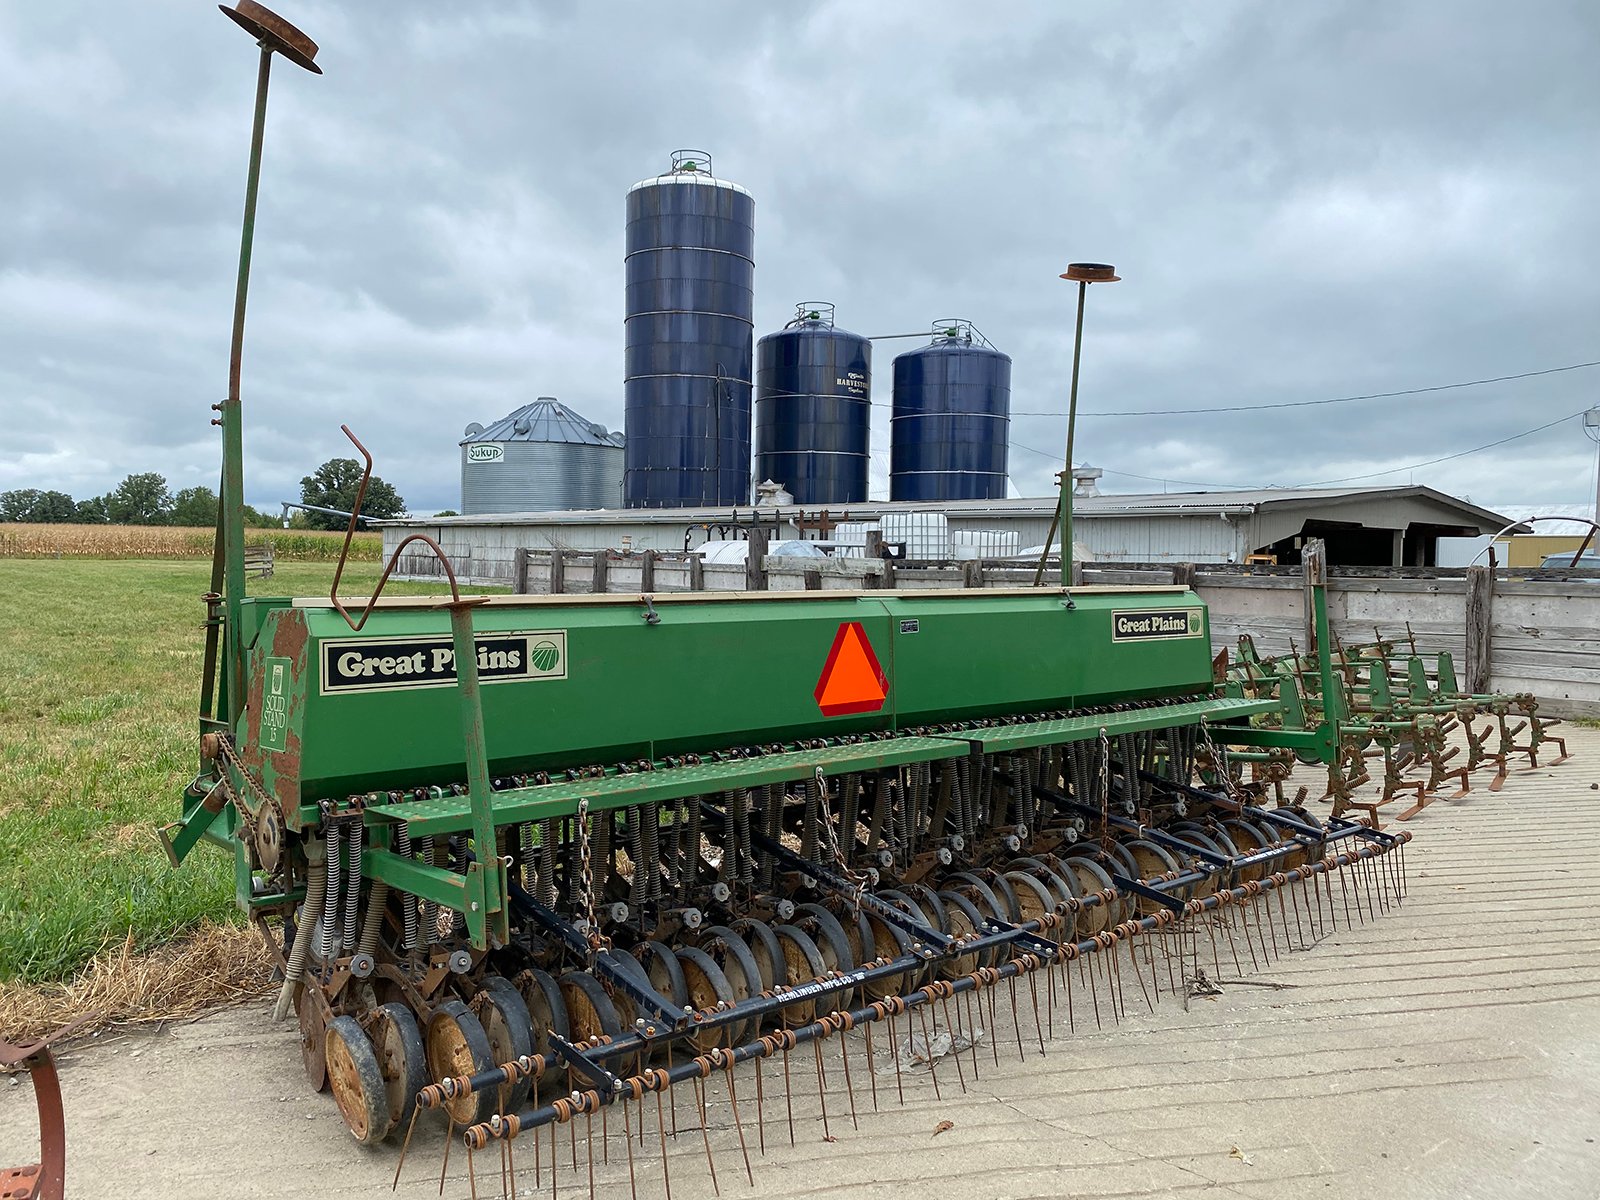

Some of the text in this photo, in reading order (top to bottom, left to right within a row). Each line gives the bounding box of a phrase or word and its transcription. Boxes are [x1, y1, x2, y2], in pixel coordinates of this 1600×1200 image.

[470, 446, 499, 459] Sukup
[1117, 616, 1186, 633] Great Plains
[337, 646, 521, 678] Great Pins
[265, 694, 286, 713] SOLID
[263, 709, 286, 729] STAND
